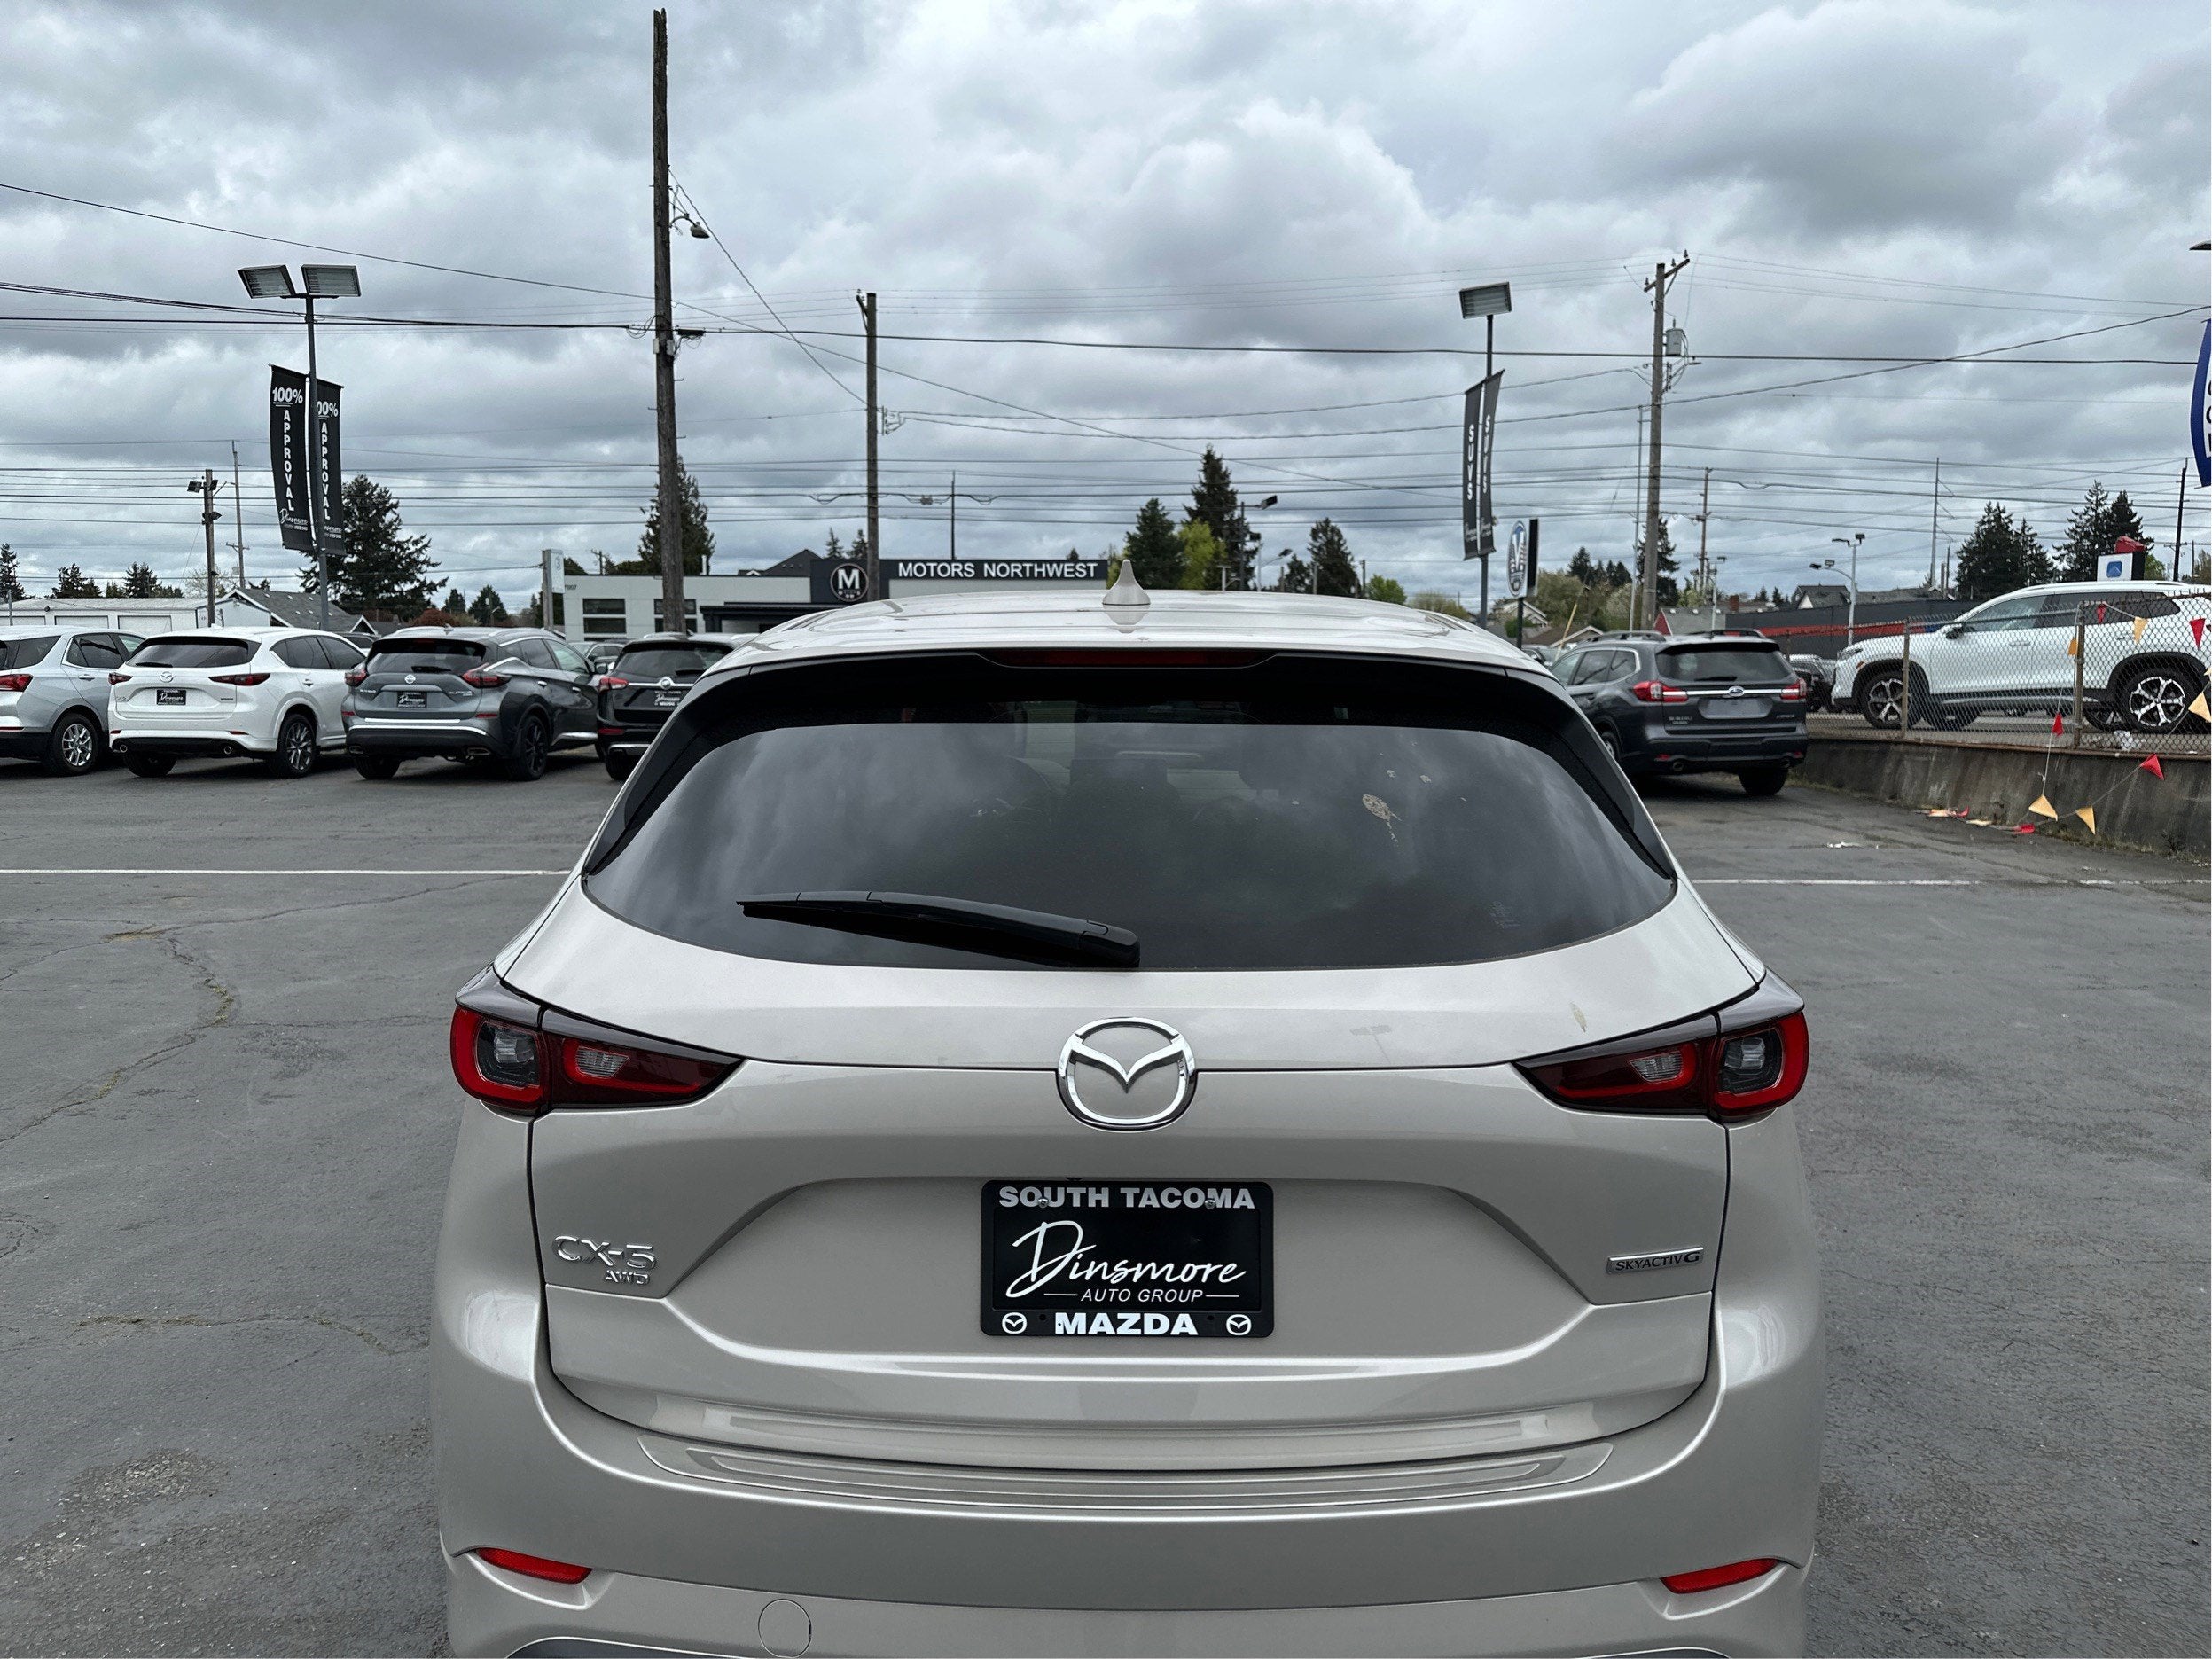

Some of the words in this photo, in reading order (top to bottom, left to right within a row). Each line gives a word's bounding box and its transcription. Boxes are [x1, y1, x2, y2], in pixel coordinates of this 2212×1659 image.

[272, 387, 303, 404] 100%
[317, 400, 339, 417] 00%
[284, 409, 294, 511] APPROVAL
[321, 422, 331, 520] APPROVAL
[838, 568, 860, 590] M
[898, 562, 975, 578] MOTORS
[983, 562, 1098, 578] NORTHWEST
[999, 1186, 1109, 1208] SOUTH
[1120, 1187, 1255, 1209] TACOMA
[551, 1235, 656, 1270] CX-5
[1005, 1220, 1247, 1298] Dinsmore
[603, 1270, 651, 1286] AWD
[1081, 1288, 1132, 1302] AUTO
[1137, 1288, 1203, 1303] GROUP
[1054, 1312, 1198, 1335] MAZDA
